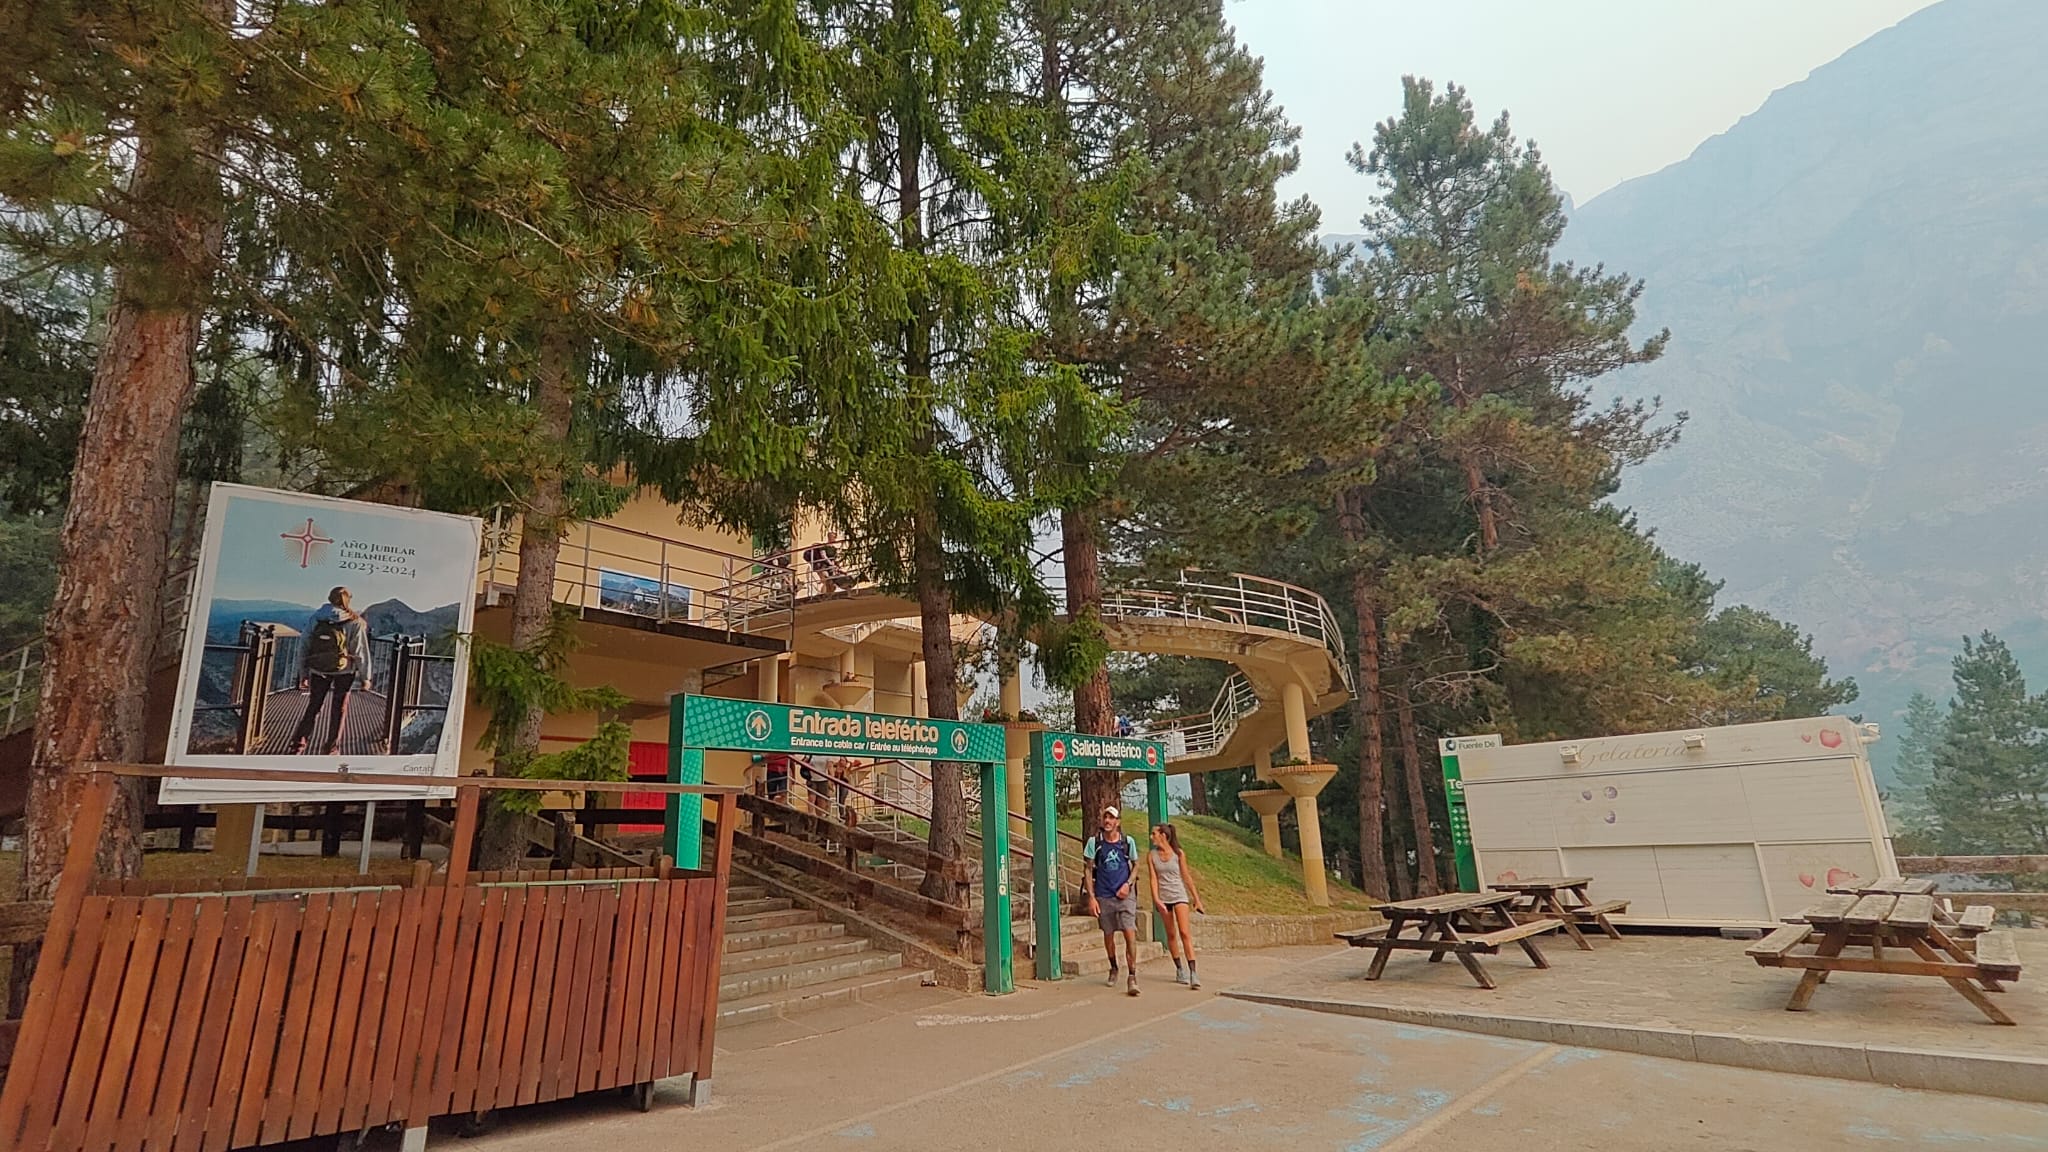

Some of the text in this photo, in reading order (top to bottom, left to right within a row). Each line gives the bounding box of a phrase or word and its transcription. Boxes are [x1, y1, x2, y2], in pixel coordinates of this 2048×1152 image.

[340, 540, 416, 556] AÑO JUBILAR
[340, 549, 406, 564] LEBANIEGO
[788, 709, 939, 743] Entrada teleférico
[791, 736, 824, 748] Entrance
[824, 739, 833, 748] to
[833, 740, 853, 749] cable
[853, 742, 865, 750] car
[1071, 738, 1142, 759] Salida teleférico
